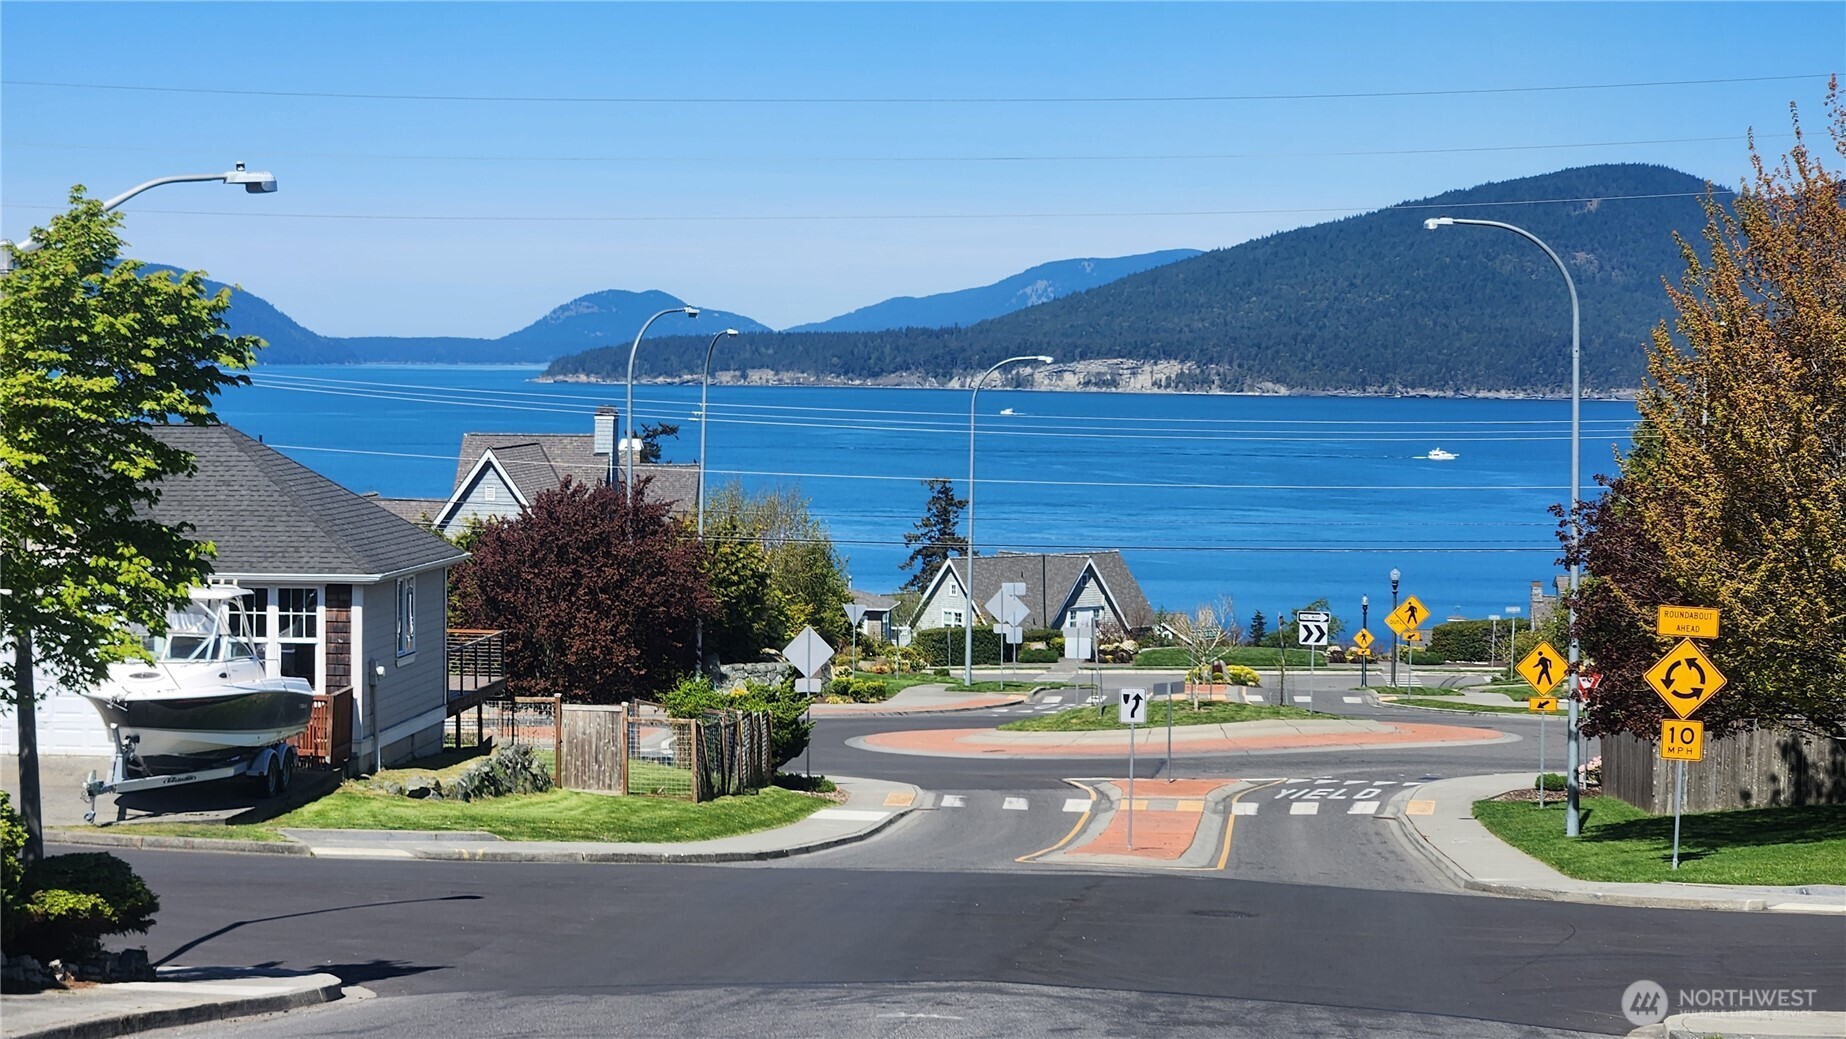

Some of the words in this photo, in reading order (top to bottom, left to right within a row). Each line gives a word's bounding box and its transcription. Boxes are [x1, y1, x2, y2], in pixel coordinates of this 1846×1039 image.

[1664, 610, 1713, 620] ROUNDABOUT
[1676, 624, 1700, 633] AHEAD
[1669, 726, 1695, 745] 10
[1667, 746, 1693, 755] MPH
[1274, 788, 1382, 799] YIELD
